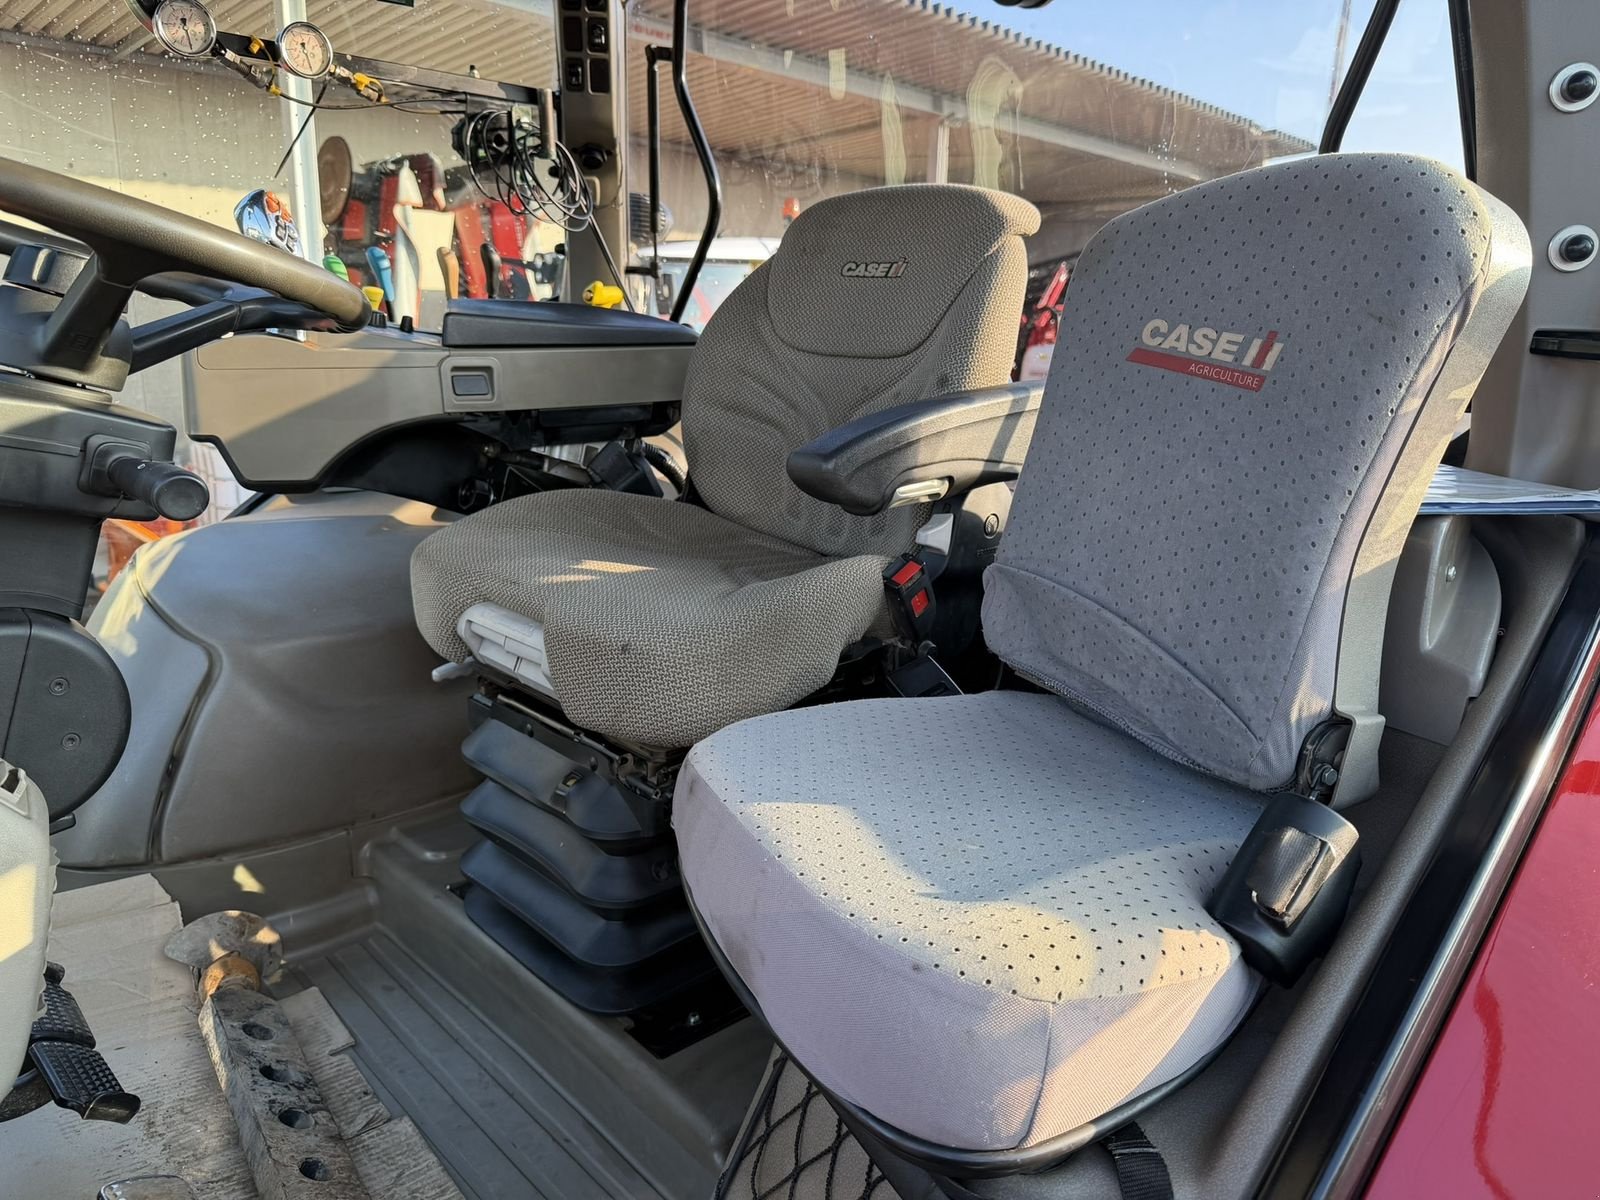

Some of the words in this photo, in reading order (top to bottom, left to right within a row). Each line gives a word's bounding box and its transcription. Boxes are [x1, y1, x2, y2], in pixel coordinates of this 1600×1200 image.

[841, 262, 891, 277] CASE
[1141, 318, 1245, 363] CASE
[1189, 362, 1260, 388] AGRICULTURE
